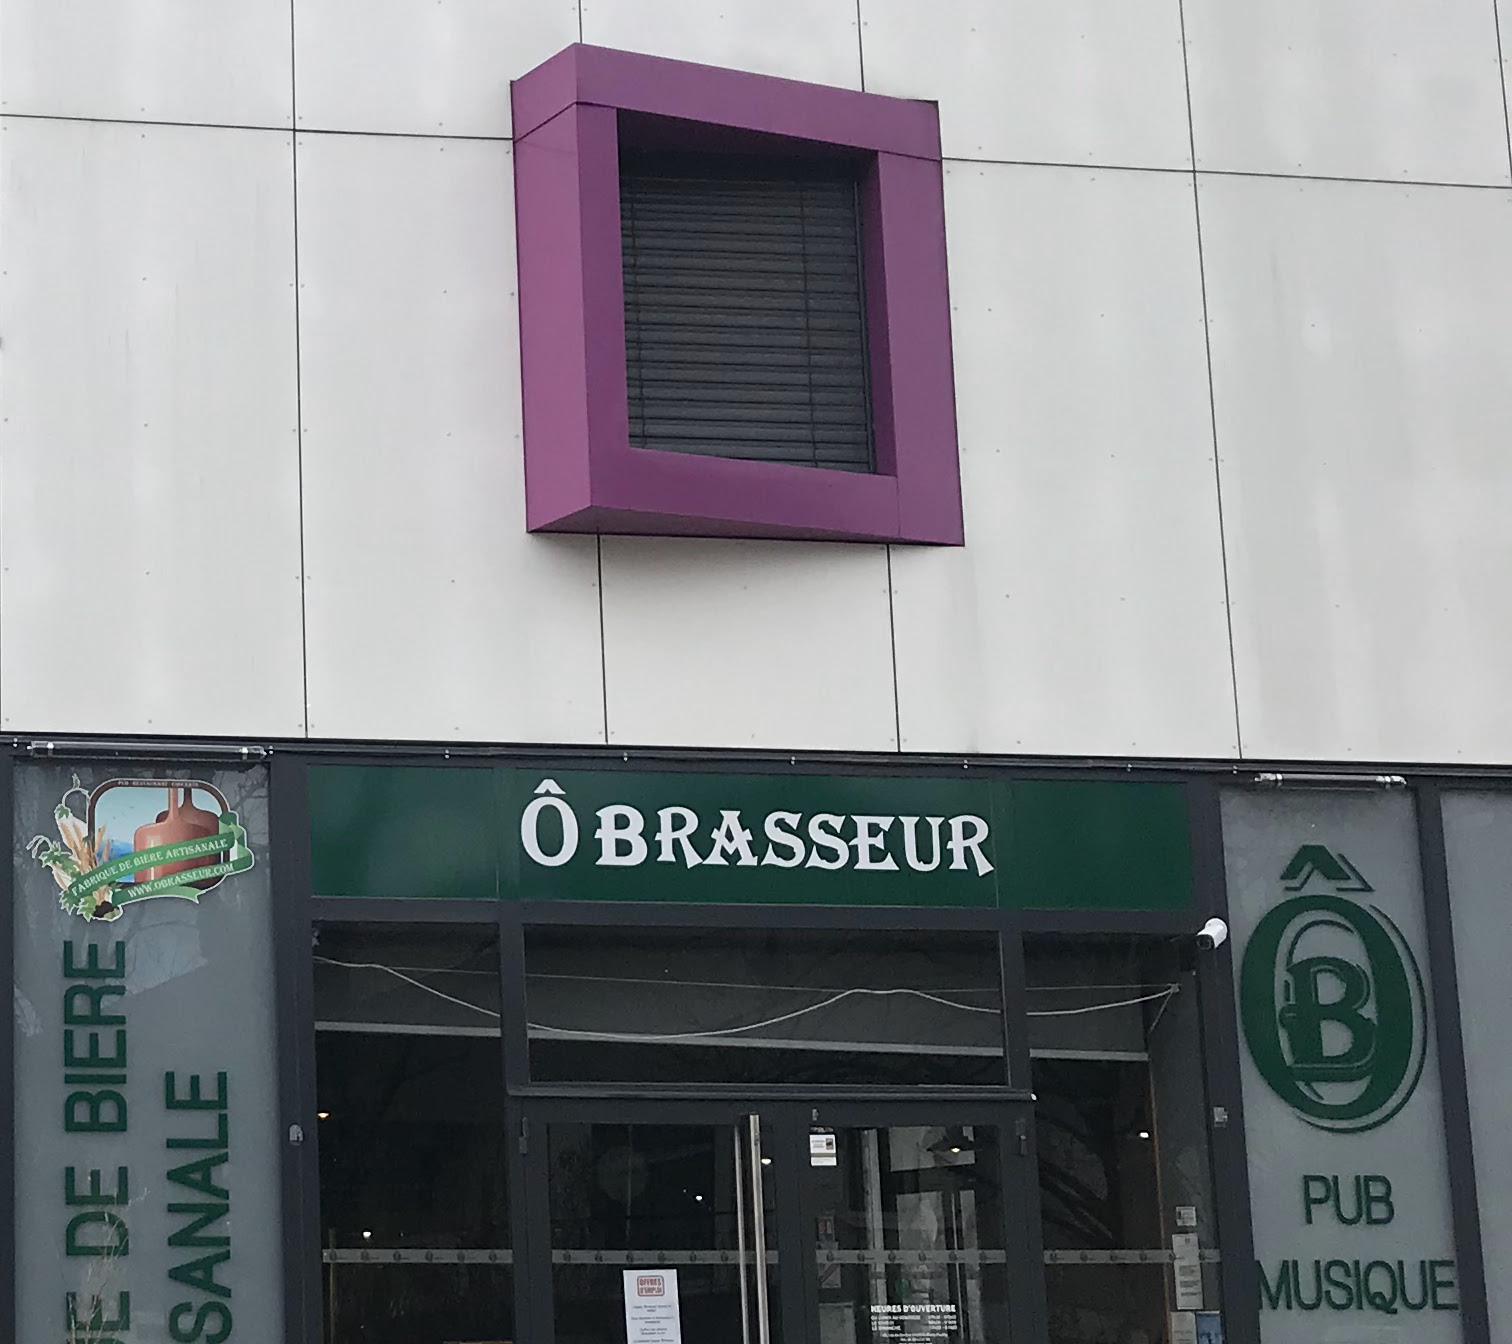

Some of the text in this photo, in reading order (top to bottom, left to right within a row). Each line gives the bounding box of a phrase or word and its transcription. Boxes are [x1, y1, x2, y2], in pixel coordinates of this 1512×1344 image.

[521, 778, 995, 877] Ô BRASSEUR
[71, 866, 119, 897] FABRIQUE
[118, 859, 132, 872] DE
[165, 837, 228, 859] ARTISANALE
[127, 863, 234, 898] WWW.OBRASSEUR.COM
[63, 940, 128, 1133] BIERE
[65, 1166, 129, 1257] DE
[1303, 1174, 1395, 1225] PUB
[871, 1304, 957, 1313] HEURES D'OUVERTURE
[1255, 1259, 1459, 1314] MUSIQUE
